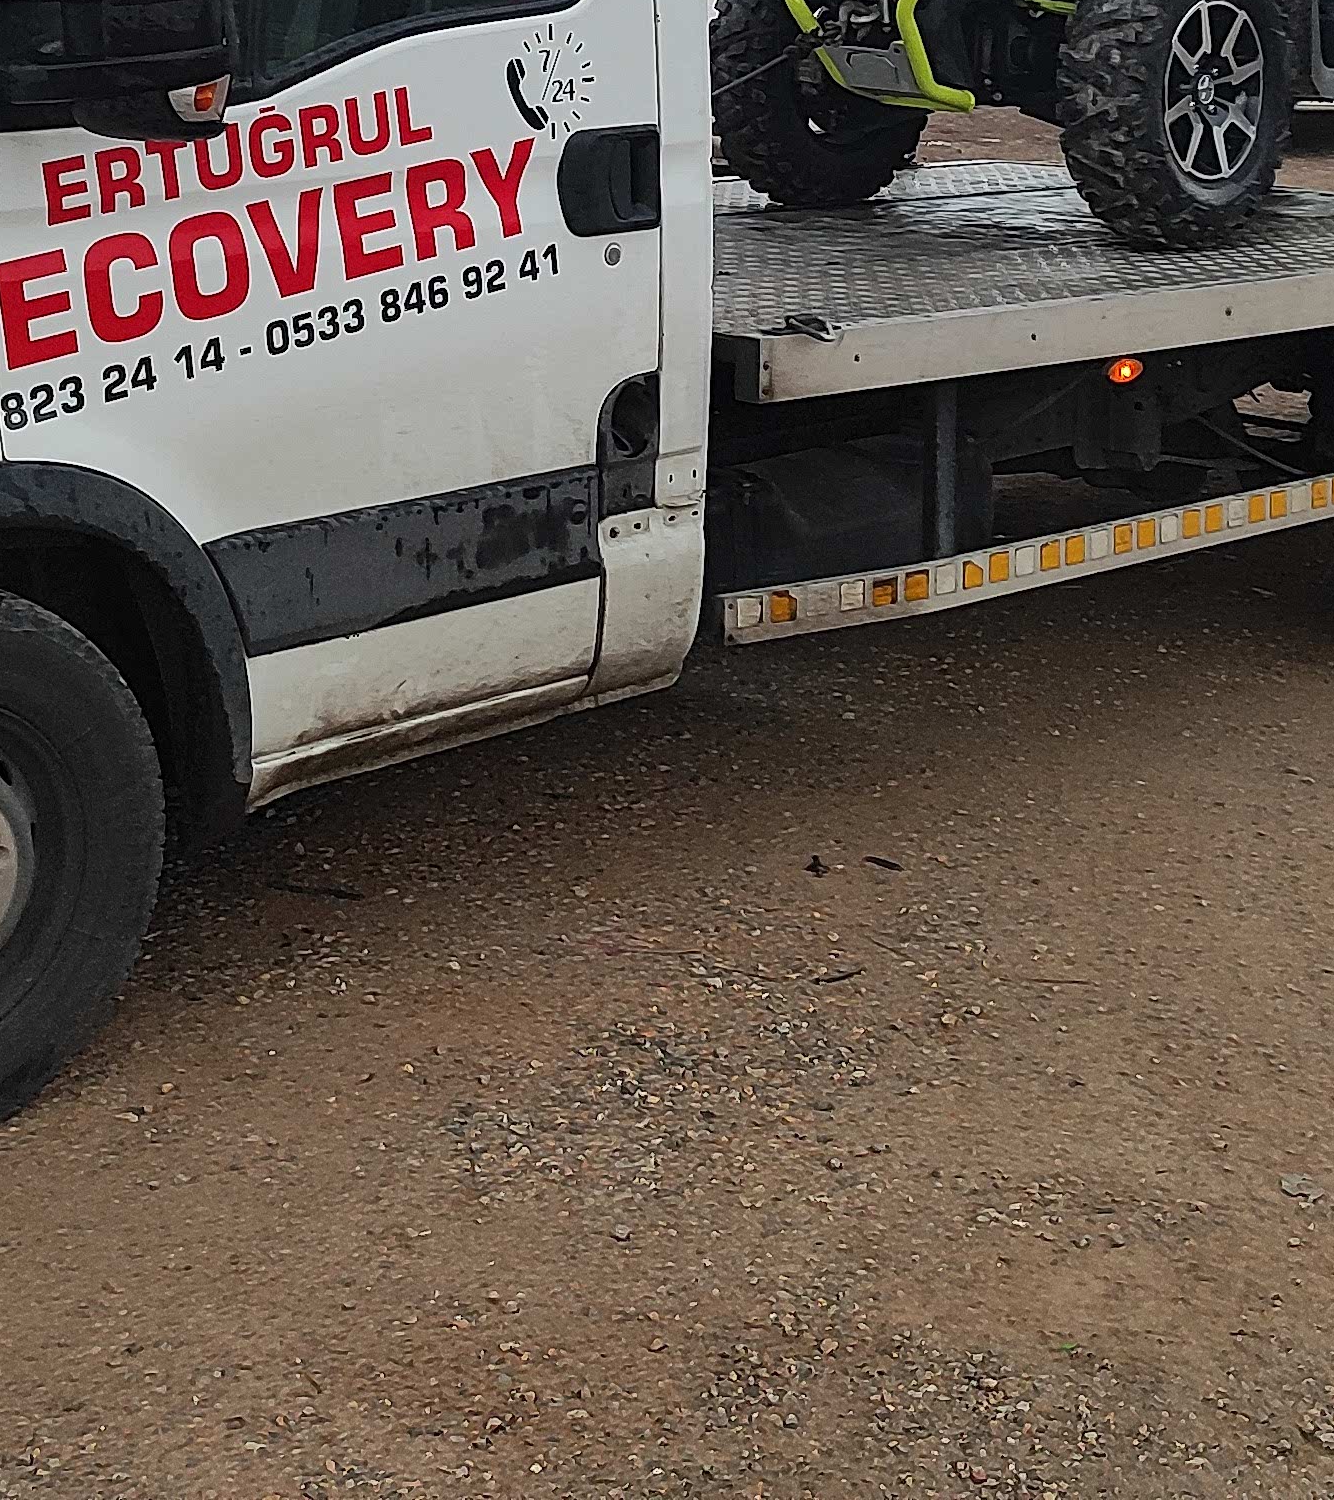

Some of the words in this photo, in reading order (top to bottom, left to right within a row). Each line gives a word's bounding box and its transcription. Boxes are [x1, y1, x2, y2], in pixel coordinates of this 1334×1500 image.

[41, 86, 433, 227] ERTUĞRUL
[0, 376, 85, 431] 823
[102, 356, 157, 403] 24
[174, 337, 225, 380] 14
[266, 299, 365, 356] 0533
[380, 276, 450, 323] 846
[463, 259, 506, 300] 92
[518, 244, 561, 281] 41
